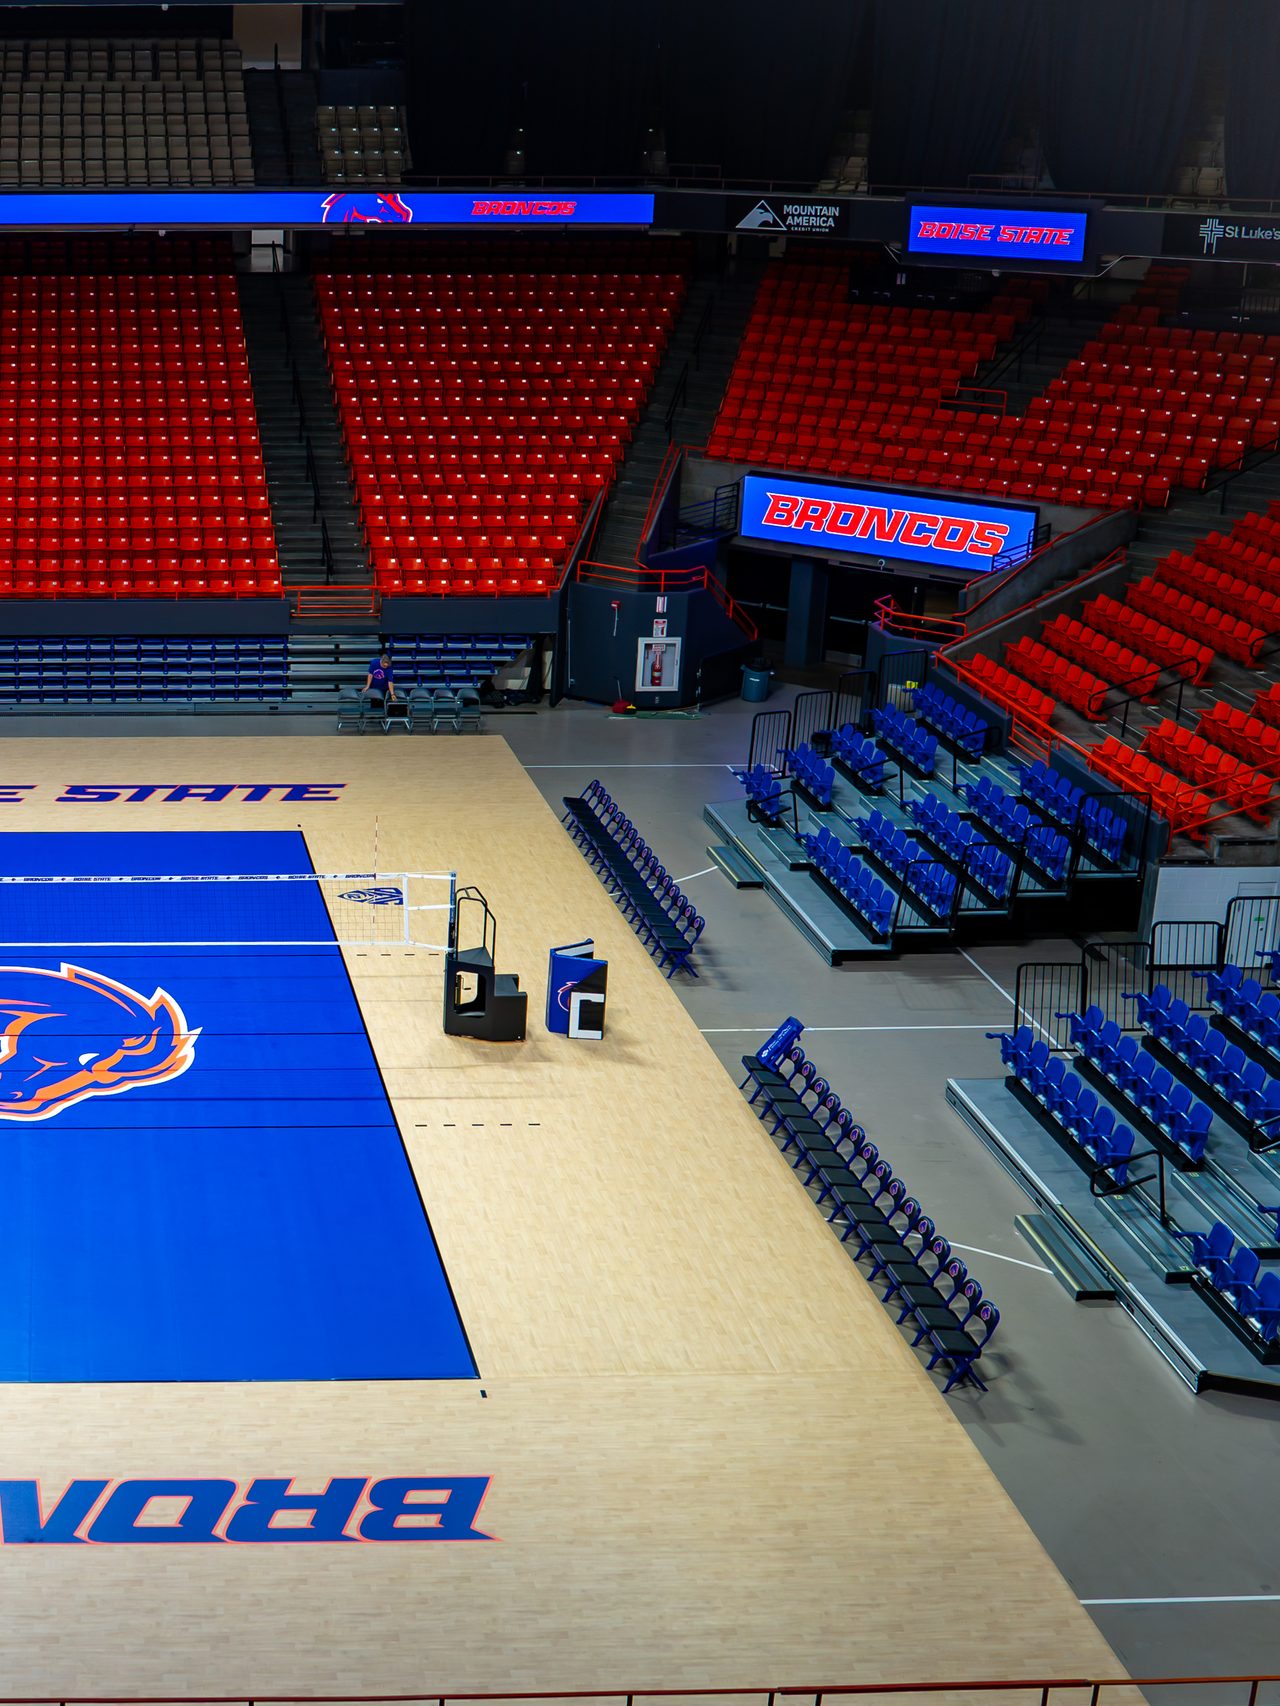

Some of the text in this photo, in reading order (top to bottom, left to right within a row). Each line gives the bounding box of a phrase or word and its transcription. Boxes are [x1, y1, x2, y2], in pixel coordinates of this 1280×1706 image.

[471, 200, 577, 216] BRONCOS
[783, 204, 840, 217] MOUNTAIN
[785, 216, 835, 228] AMERICA
[918, 221, 1074, 246] BOISE STATE
[1224, 225, 1280, 240] St Luke's
[761, 492, 1010, 557] BRONCOS
[54, 783, 347, 803] STATE
